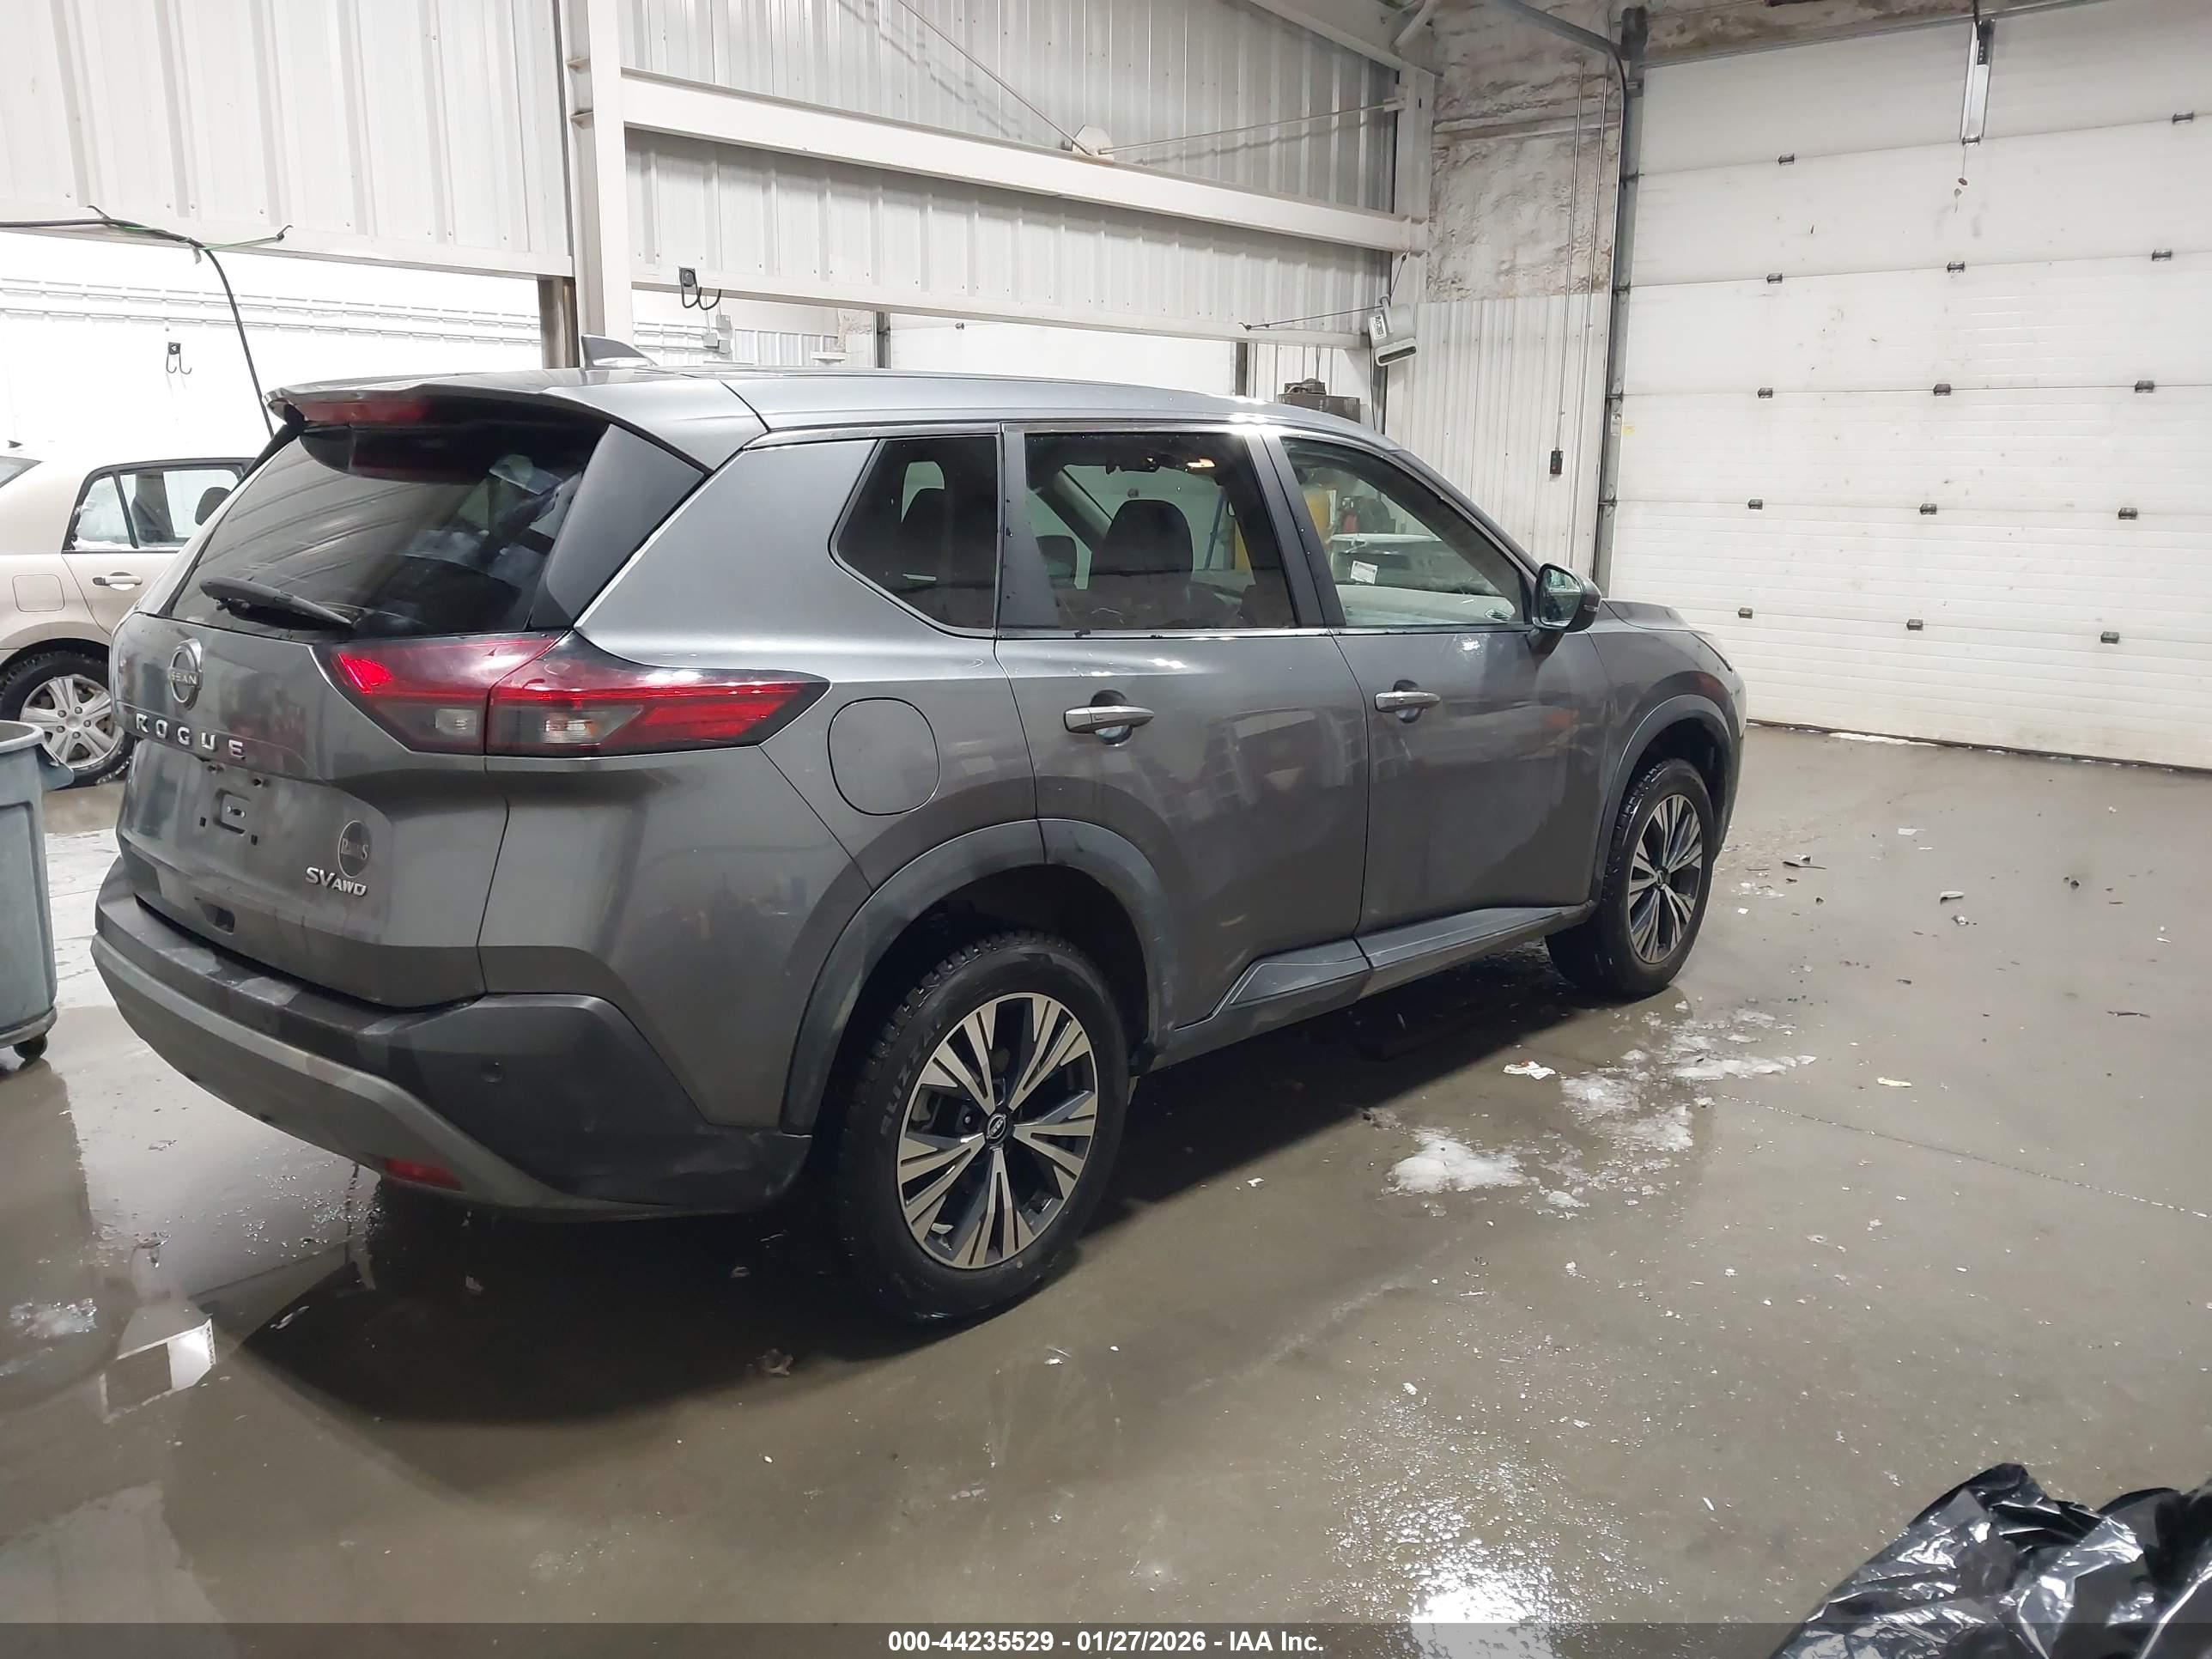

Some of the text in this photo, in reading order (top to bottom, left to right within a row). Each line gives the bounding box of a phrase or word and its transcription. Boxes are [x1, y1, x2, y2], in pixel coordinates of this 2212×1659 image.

[136, 713, 245, 758] ROGUE
[305, 866, 368, 896] SV AWD
